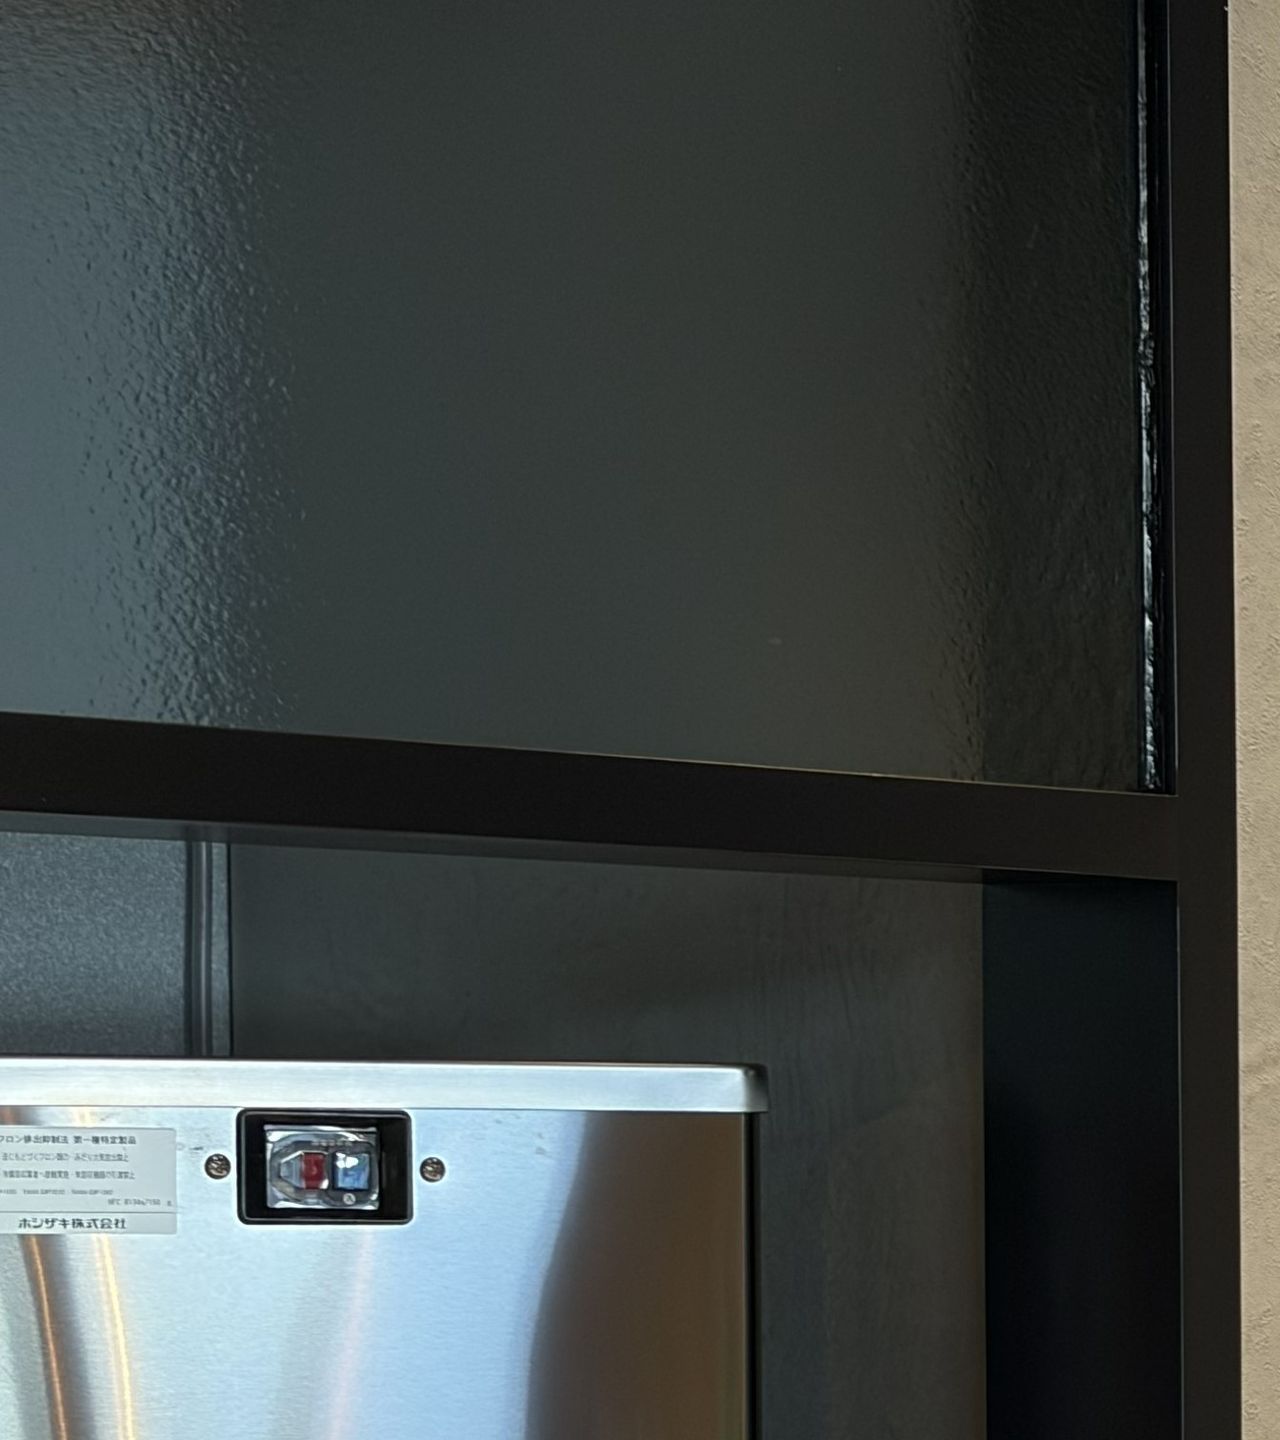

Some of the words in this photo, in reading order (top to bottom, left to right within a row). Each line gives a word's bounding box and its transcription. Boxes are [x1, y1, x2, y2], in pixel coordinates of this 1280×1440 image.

[18, 1217, 127, 1230] ホシザキ株式会社
